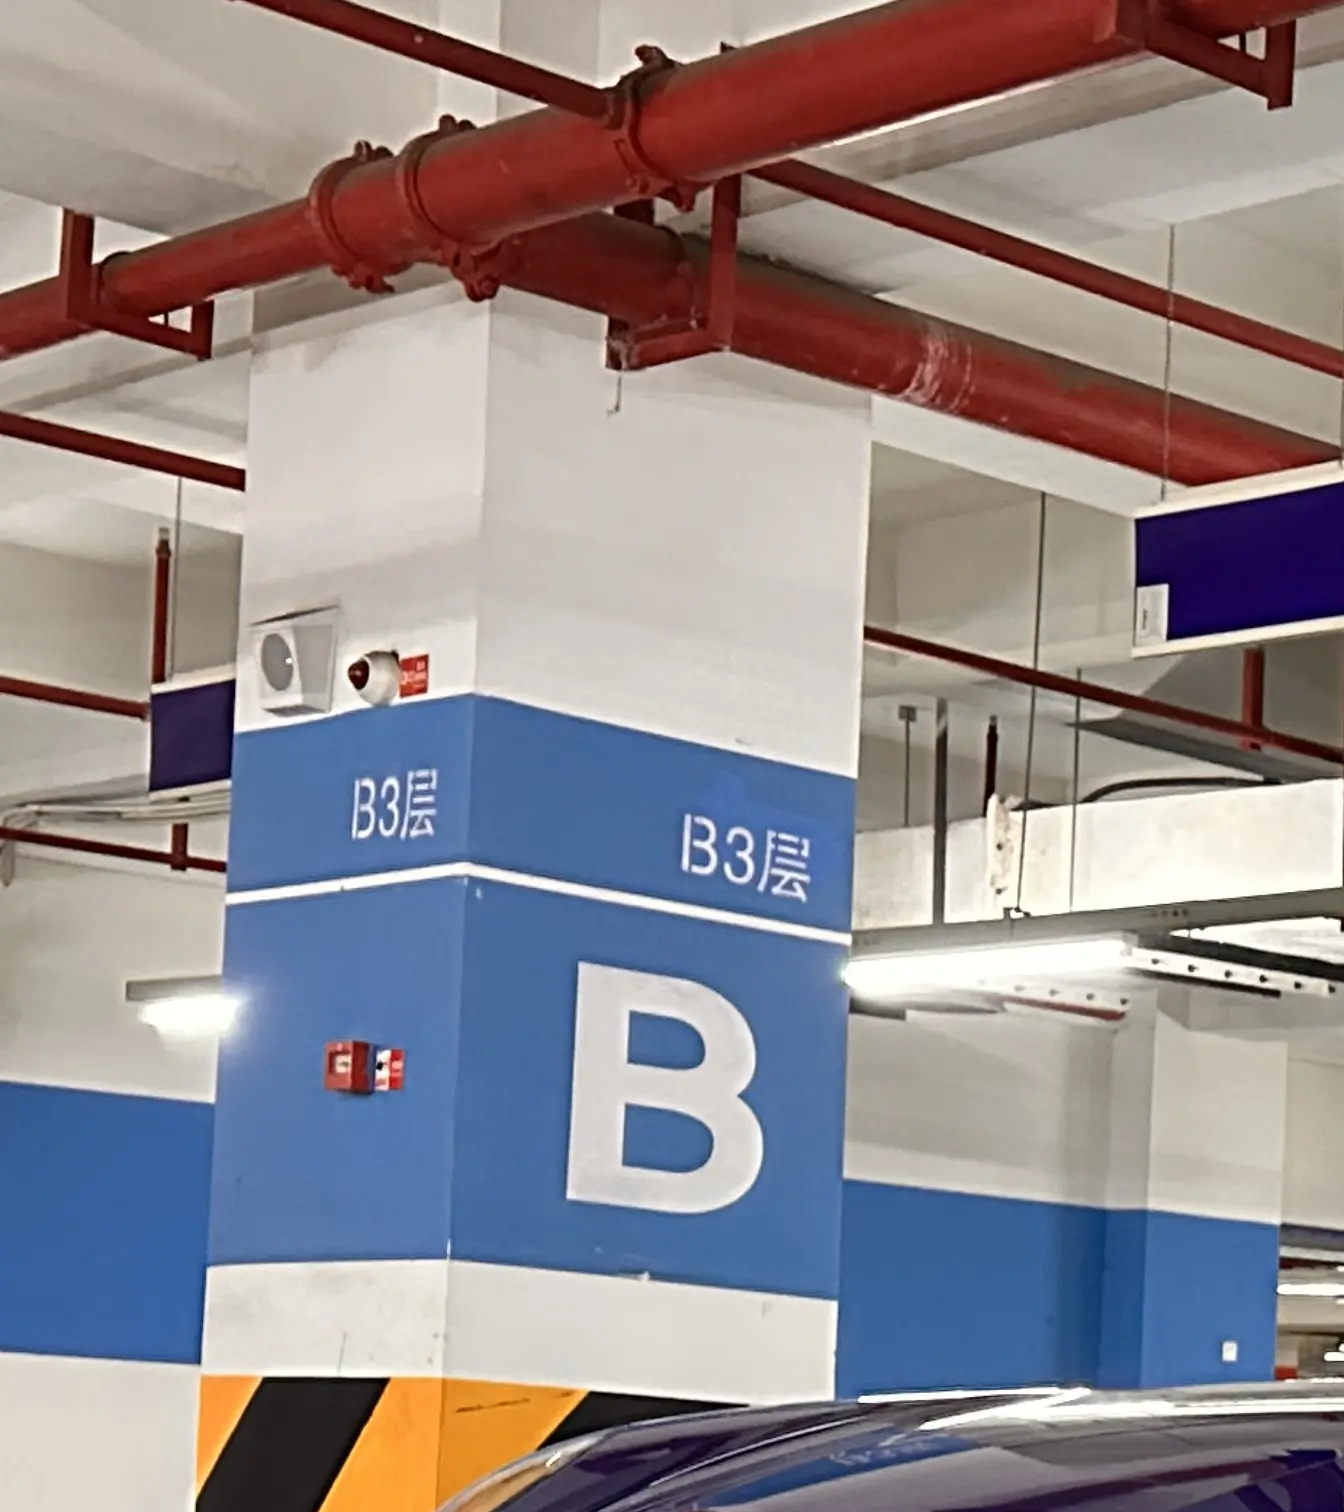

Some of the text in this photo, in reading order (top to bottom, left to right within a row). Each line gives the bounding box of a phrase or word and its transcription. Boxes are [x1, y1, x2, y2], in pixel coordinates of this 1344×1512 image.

[351, 768, 438, 840] B3层
[680, 813, 811, 902] B3层
[566, 961, 764, 1214] B
